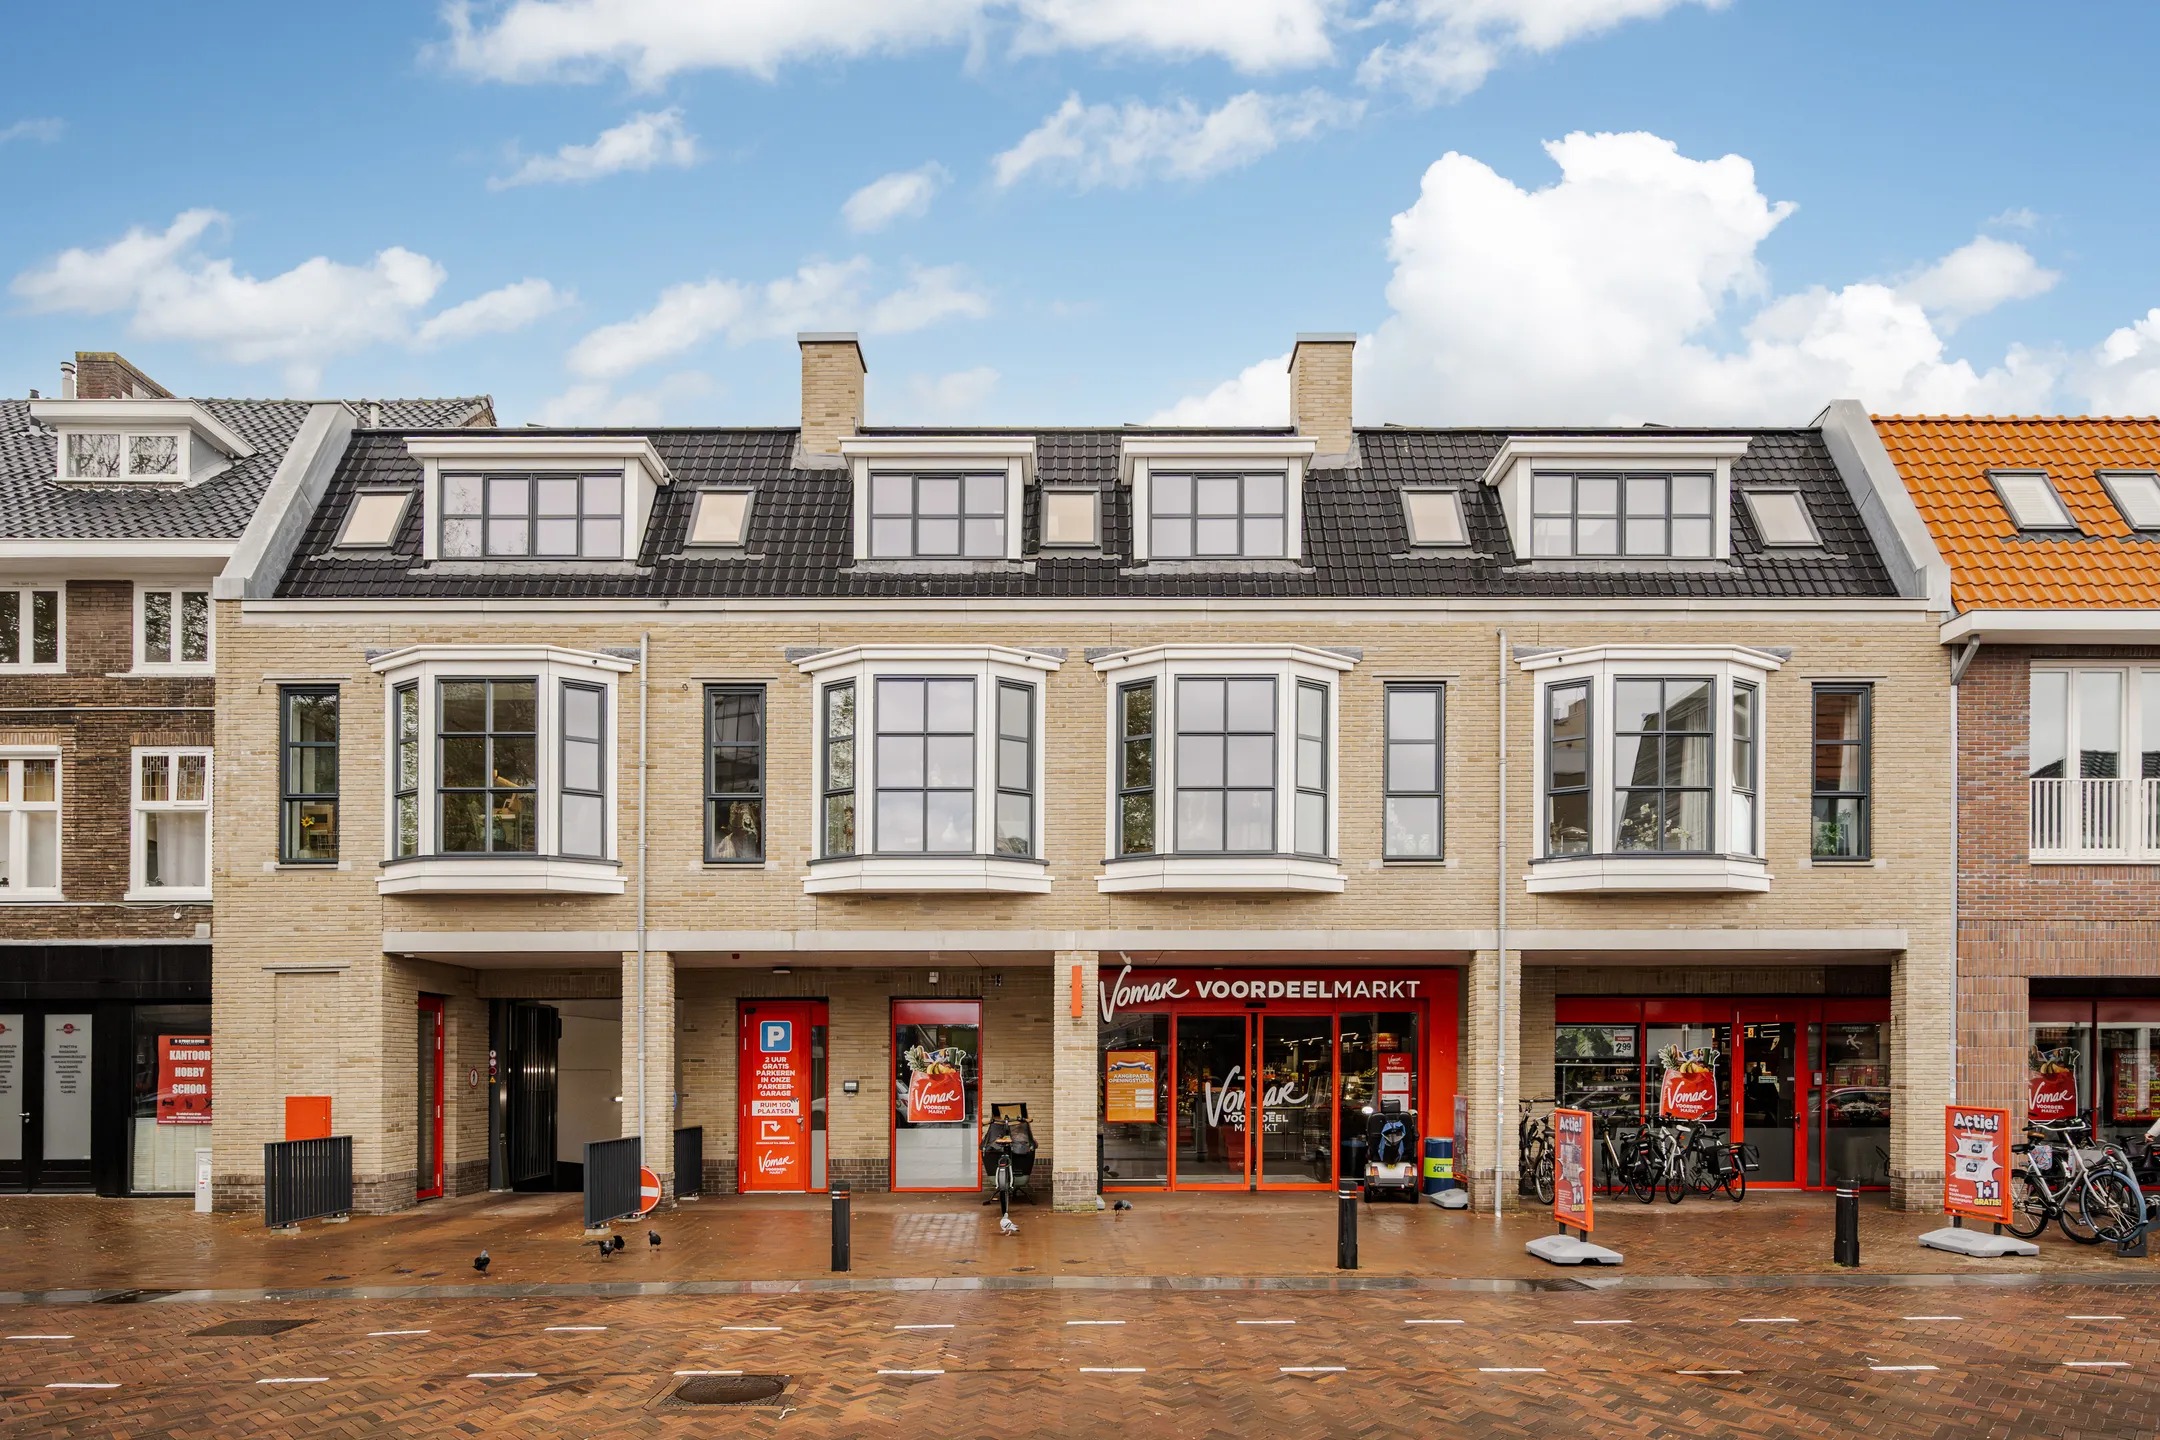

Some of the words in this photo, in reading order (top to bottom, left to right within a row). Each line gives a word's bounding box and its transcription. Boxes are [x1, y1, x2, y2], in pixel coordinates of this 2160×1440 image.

[1099, 965, 1190, 1022] Vomar
[1195, 980, 1420, 998] VOORDEELMARKT
[767, 1025, 785, 1048] P
[169, 1050, 211, 1061] KANTOOR
[174, 1067, 205, 1078] HOBBY
[172, 1083, 208, 1095] SCHOOL
[914, 1082, 960, 1111] Vomar
[1667, 1080, 1713, 1110] Vomar
[2028, 1081, 2073, 1110] Vomar
[1560, 1116, 1583, 1133] Actie!
[1953, 1112, 1999, 1132] Actie!
[1975, 1181, 1999, 1199] 1+1
[1973, 1198, 2002, 1207] GRATIS!
